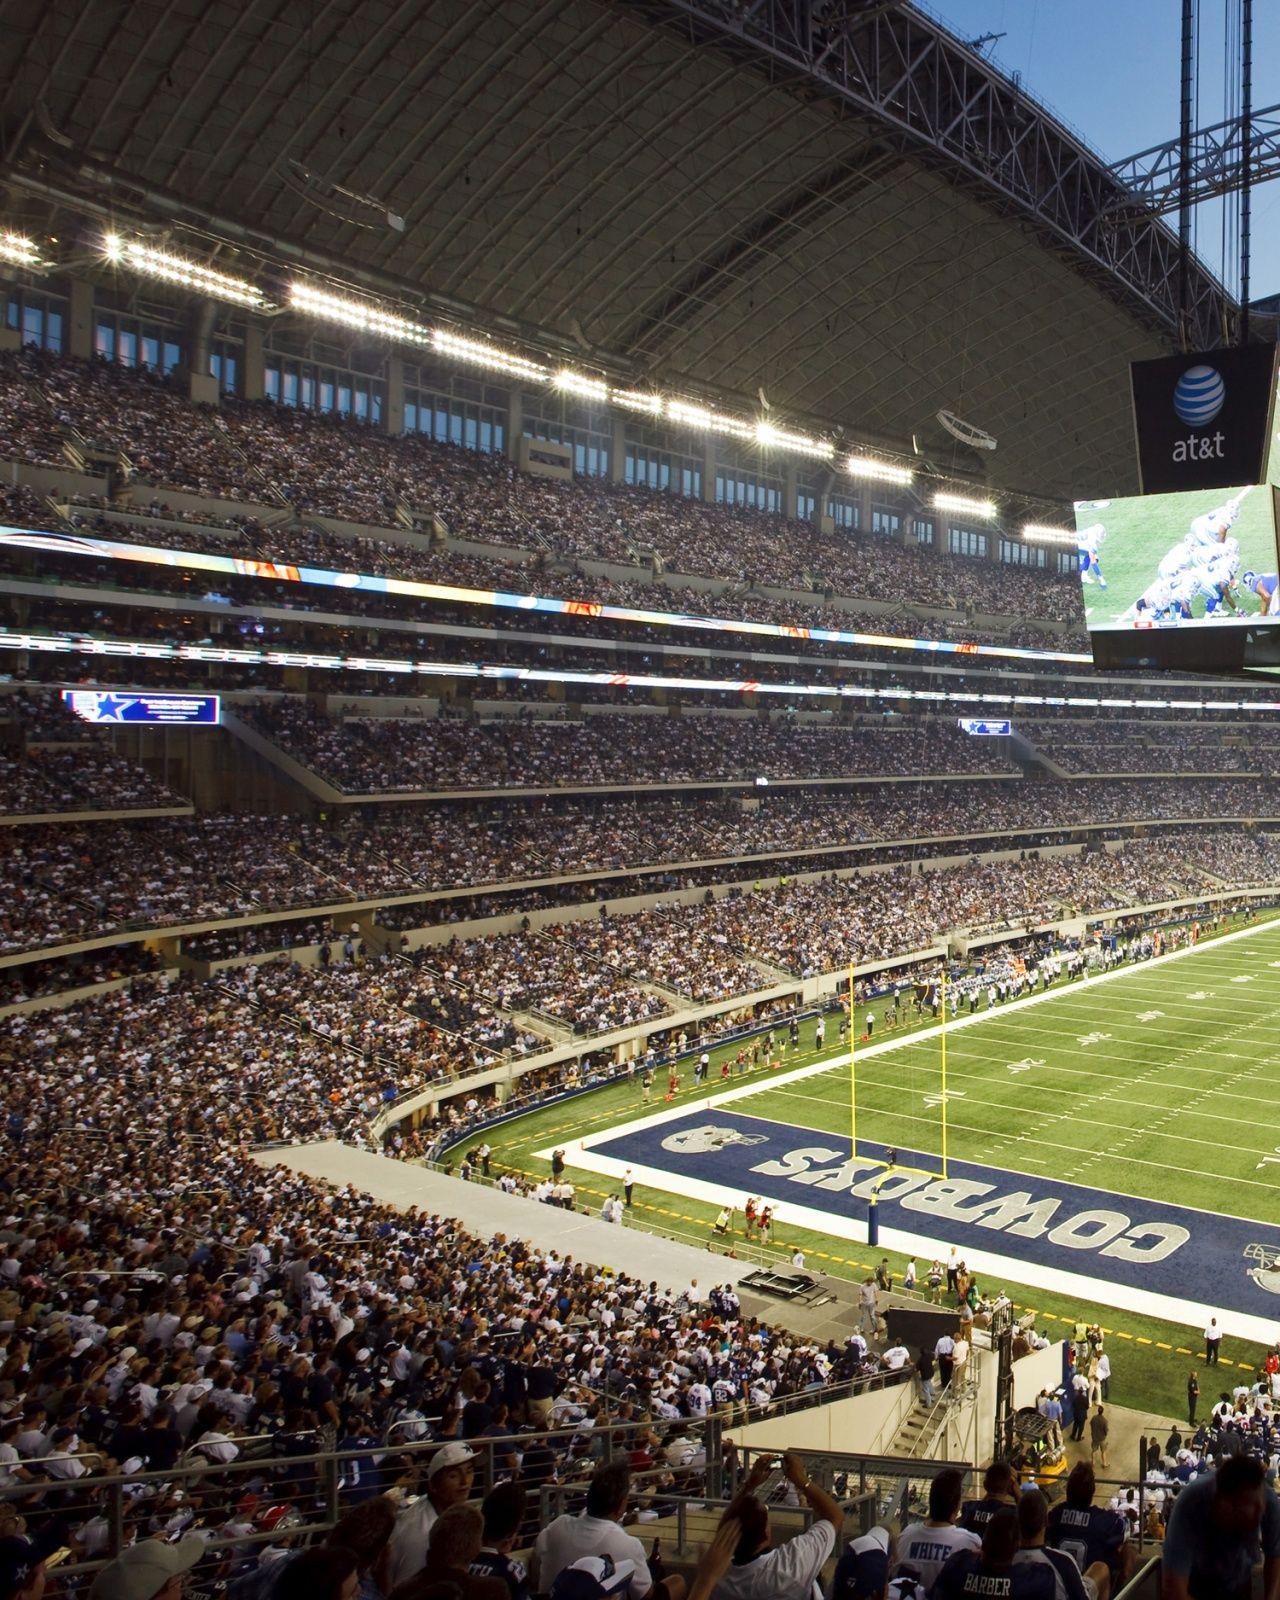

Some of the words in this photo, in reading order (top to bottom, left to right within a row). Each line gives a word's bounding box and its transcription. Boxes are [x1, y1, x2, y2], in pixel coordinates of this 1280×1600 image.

[1172, 431, 1225, 462] at&t
[749, 1147, 1191, 1263] COWBOYS
[1061, 1509, 1091, 1528] ROMO
[909, 1541, 952, 1562] WHITE
[963, 1572, 1011, 1596] BARBER
